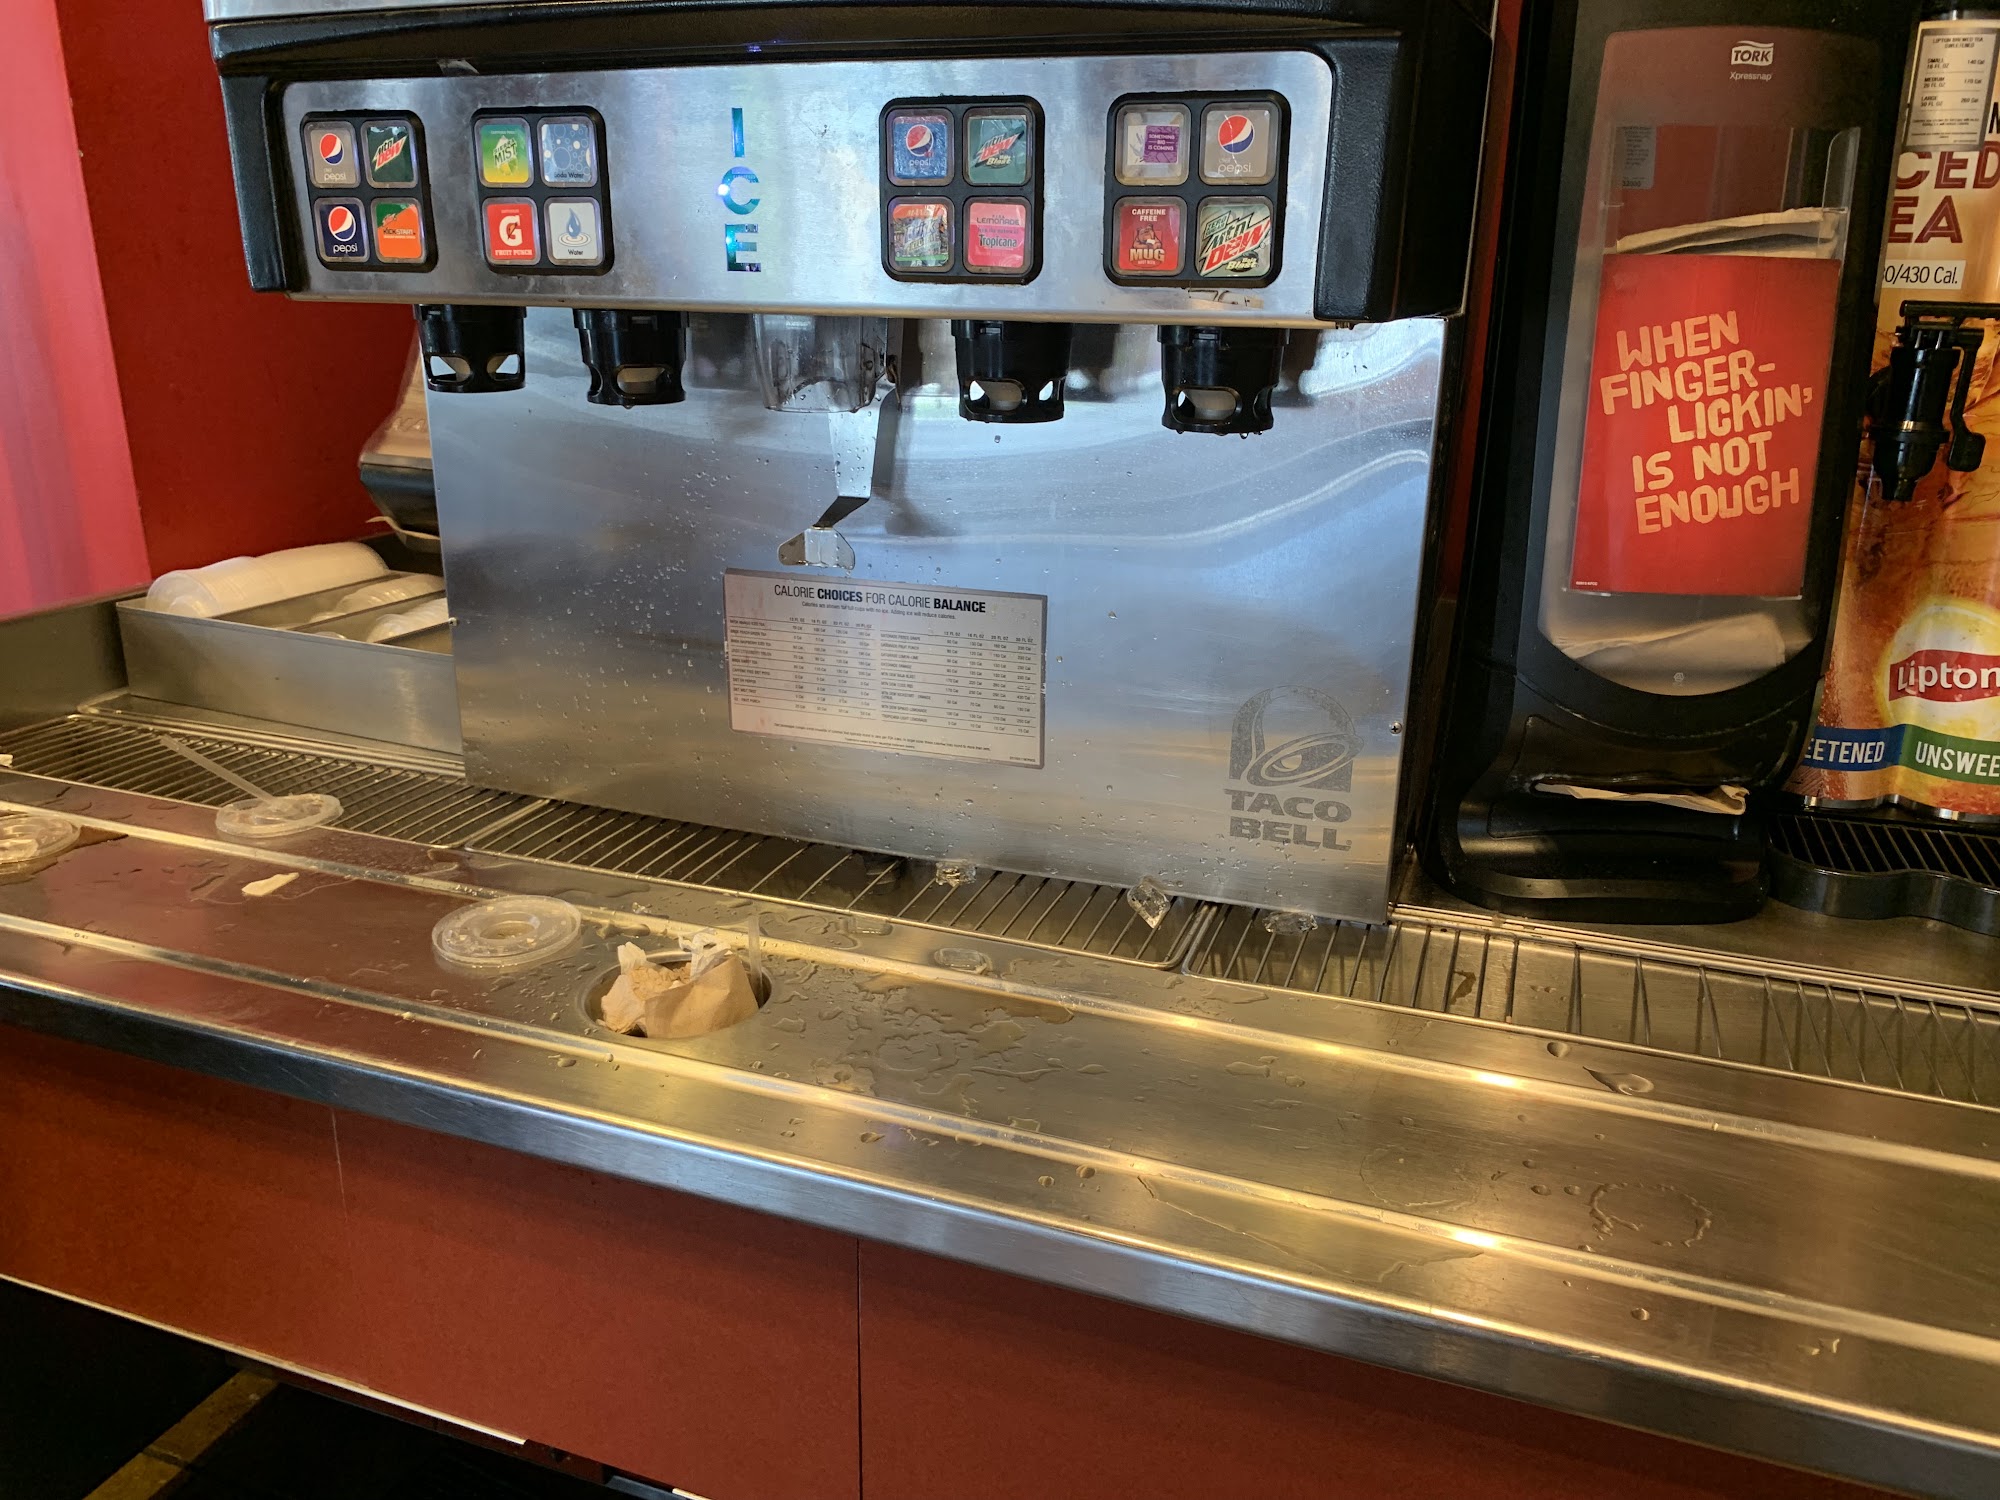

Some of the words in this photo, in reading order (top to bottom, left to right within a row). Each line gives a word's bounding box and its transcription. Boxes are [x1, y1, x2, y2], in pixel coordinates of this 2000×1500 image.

[1733, 50, 1770, 62] TORK
[1730, 71, 1772, 81] Xpressnap
[495, 142, 516, 165] MIST
[909, 159, 932, 167] pepsi
[324, 172, 346, 181] pepsi
[1217, 163, 1252, 174] pepsi
[721, 107, 761, 272] ICE
[976, 217, 1020, 225] LEMONADE
[1131, 208, 1166, 216] CAFFEINE
[499, 215, 523, 247] G
[979, 234, 1018, 248] Tropicana
[333, 243, 357, 254] pepsi
[1130, 248, 1165, 262] MUG
[1226, 260, 1258, 270] Blast
[1884, 264, 1930, 285] 0/430
[1934, 266, 1958, 284] Cal.
[1616, 310, 1739, 371] WHEN
[1600, 349, 1776, 415] FINGER-
[1667, 383, 1812, 443] LICKIN'
[1632, 450, 1674, 493] IS
[1692, 430, 1773, 481] NOT
[1635, 467, 1800, 534] ENOUGH
[774, 584, 814, 599] CALORIE
[817, 588, 863, 603] CHOICES
[865, 592, 886, 604] FOR
[888, 594, 931, 608] CALORIE
[933, 598, 986, 613] BALANCE
[890, 609, 905, 617] Adding
[1897, 660, 2000, 693] Lipton
[1915, 741, 2000, 777] UNSWEE
[1223, 788, 1351, 823] TACO
[1229, 816, 1352, 851] BELL
